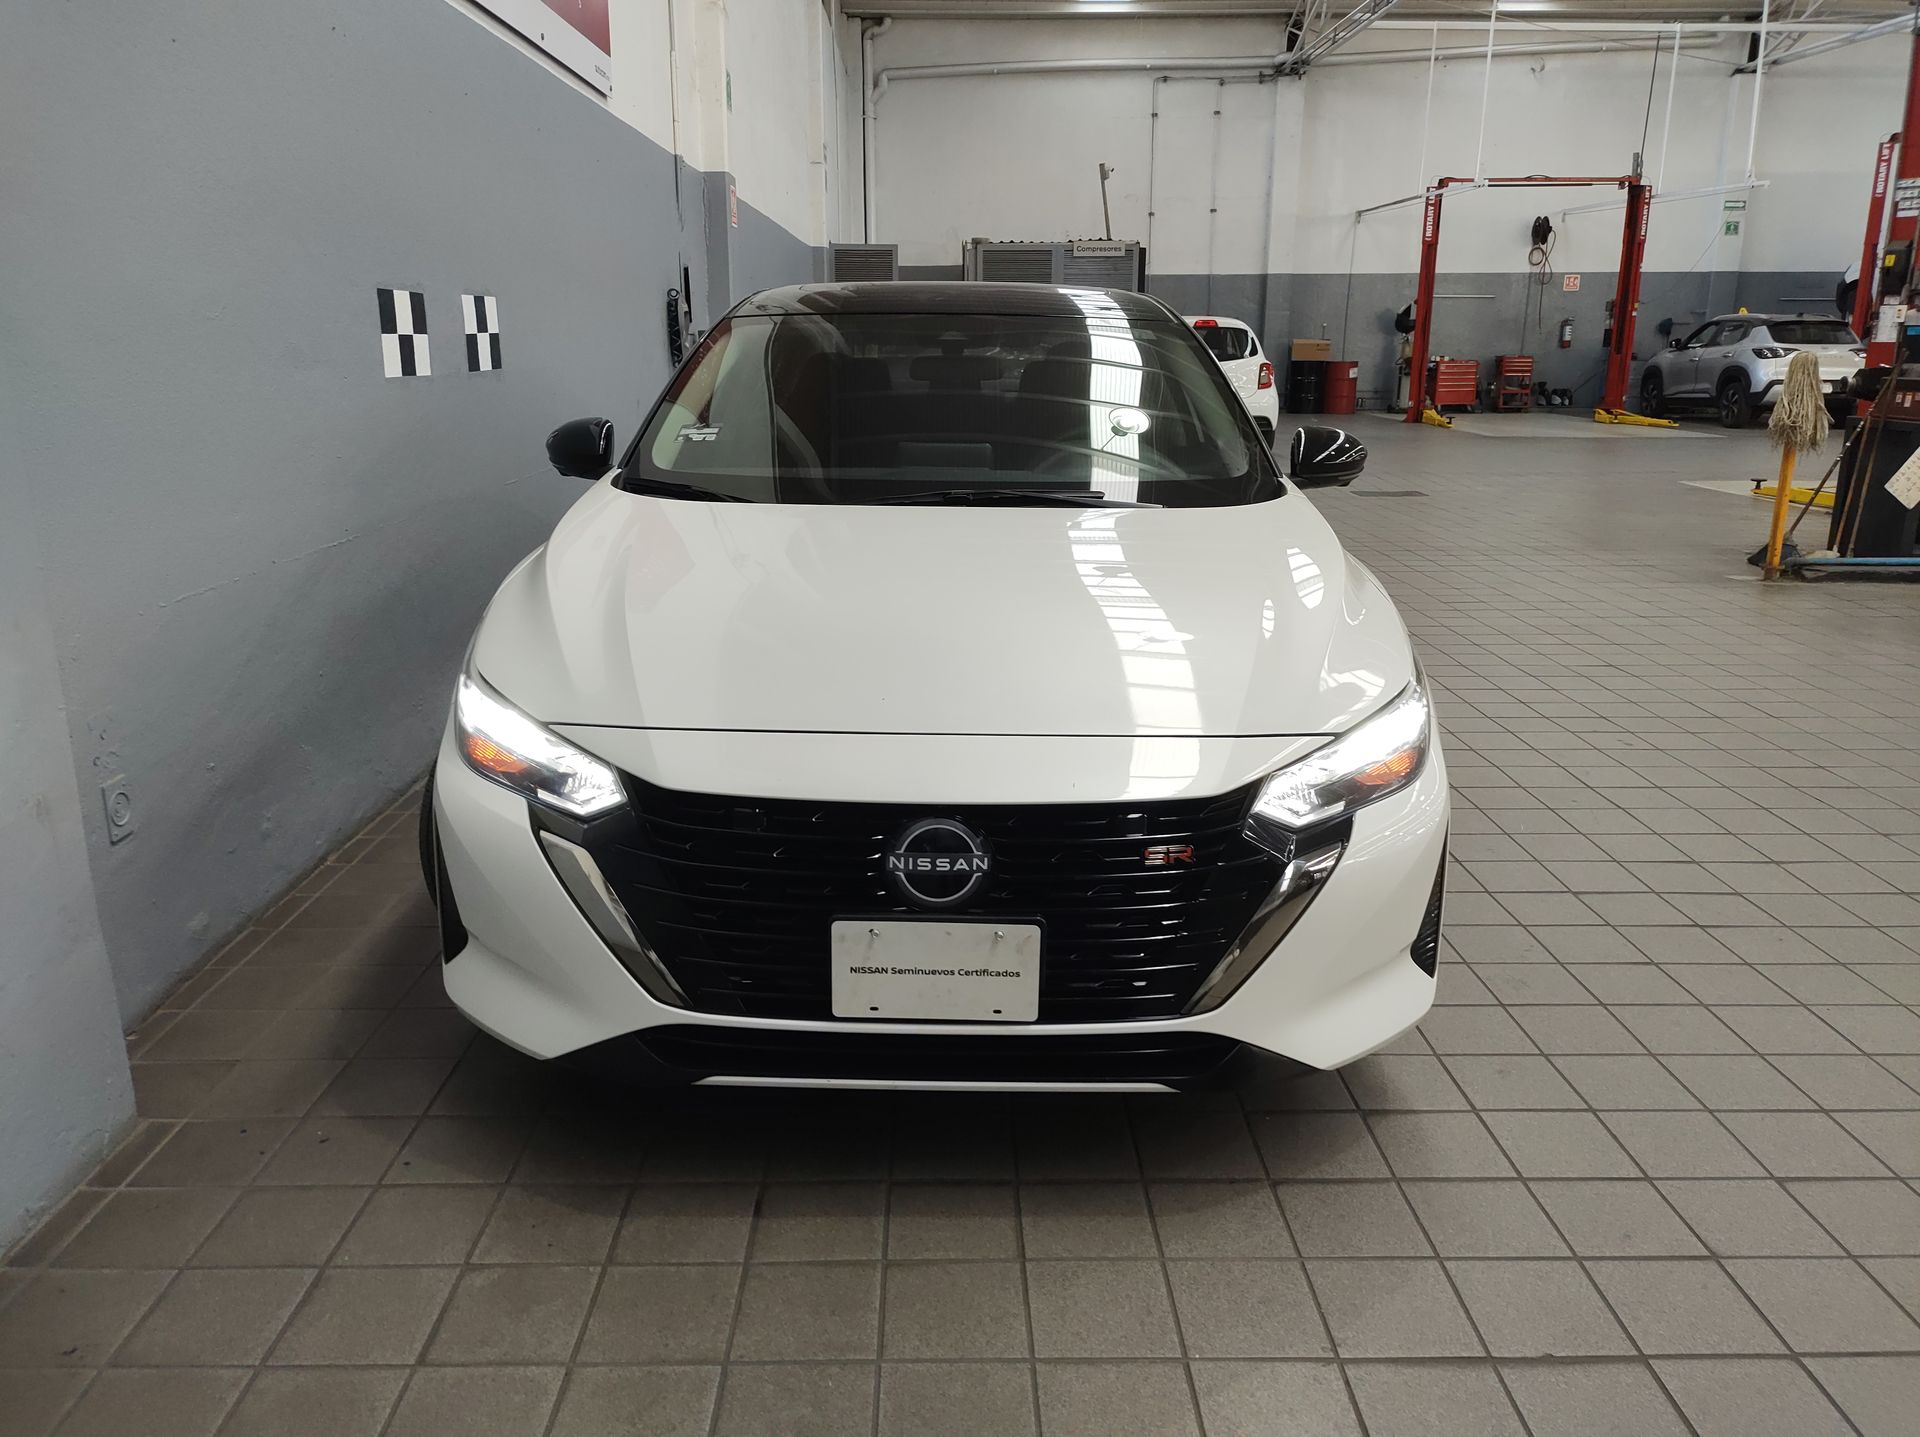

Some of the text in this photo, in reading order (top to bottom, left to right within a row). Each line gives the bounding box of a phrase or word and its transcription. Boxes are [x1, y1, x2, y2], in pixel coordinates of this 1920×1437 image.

[1876, 161, 1888, 194] ROTARY
[1425, 205, 1435, 237] ROTARY
[1640, 204, 1649, 236] ROTARY
[1076, 245, 1122, 253] Compresores
[889, 856, 989, 871] NISSAN
[1143, 845, 1194, 865] SR
[850, 966, 1021, 978] NISSAN Seminuevos Certificados
